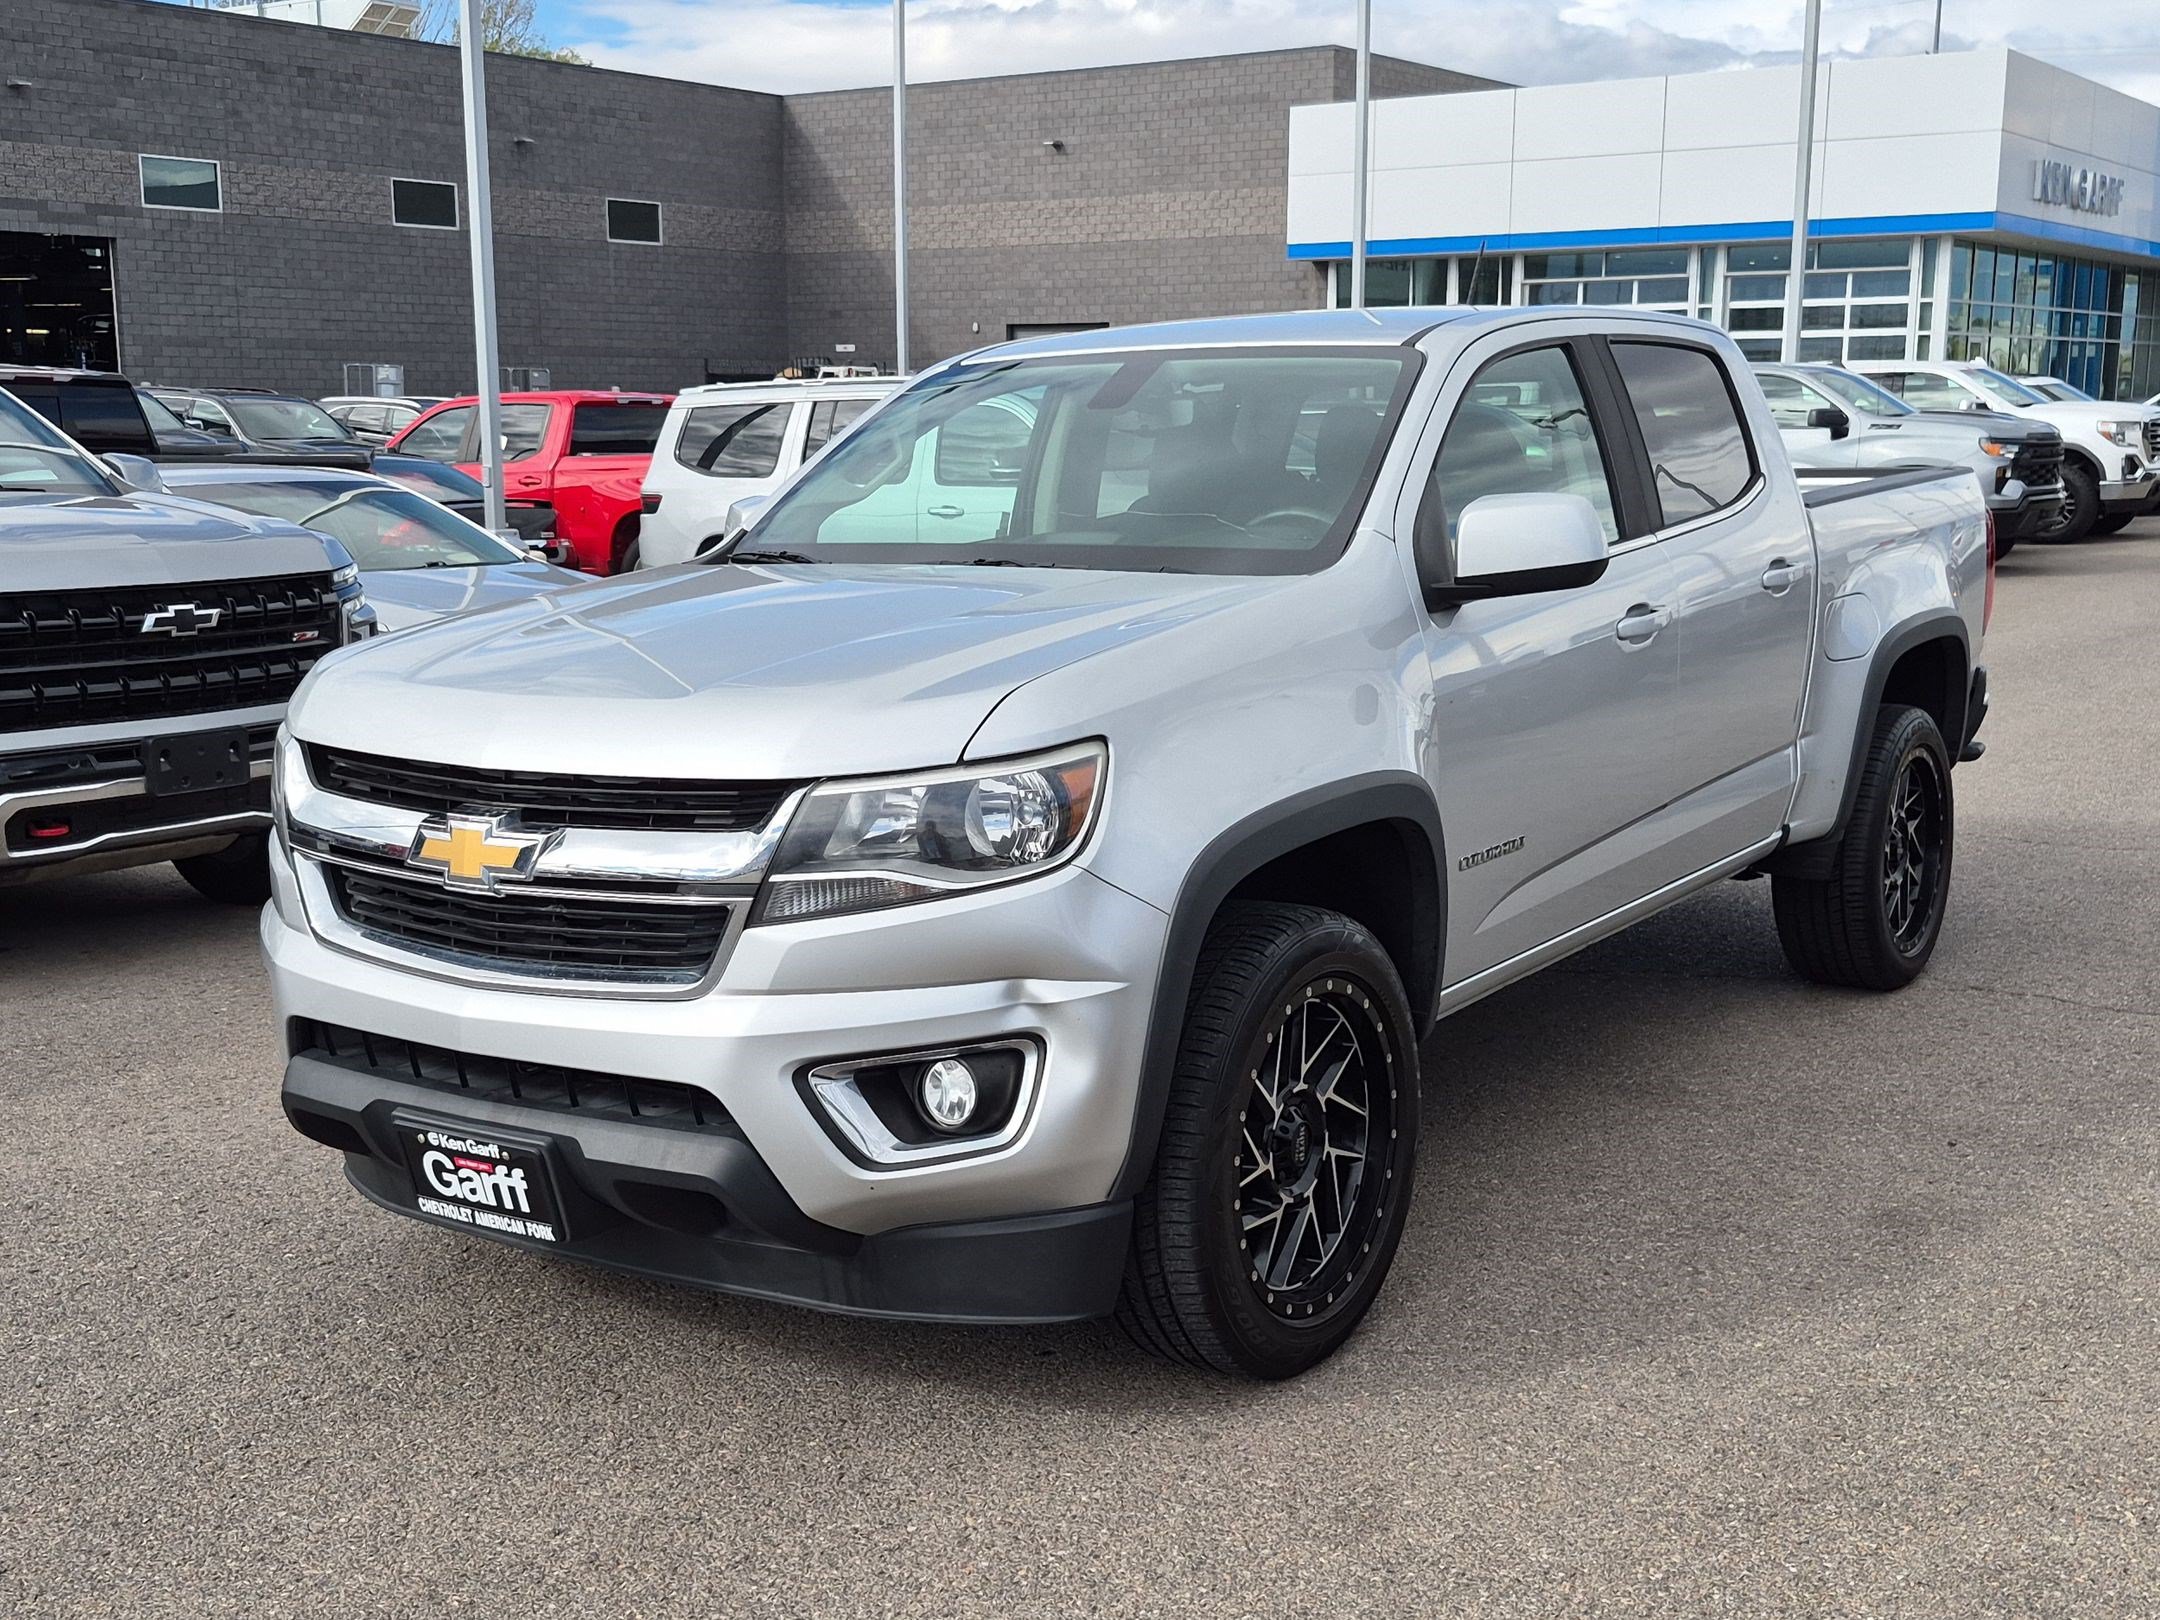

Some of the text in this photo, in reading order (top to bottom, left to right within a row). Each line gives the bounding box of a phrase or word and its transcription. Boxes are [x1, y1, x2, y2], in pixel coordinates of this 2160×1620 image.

[438, 1133, 500, 1159] Ken Garff
[422, 1150, 531, 1213] Garff
[418, 1197, 556, 1242] CHEVROLET AMERICAN FORK
